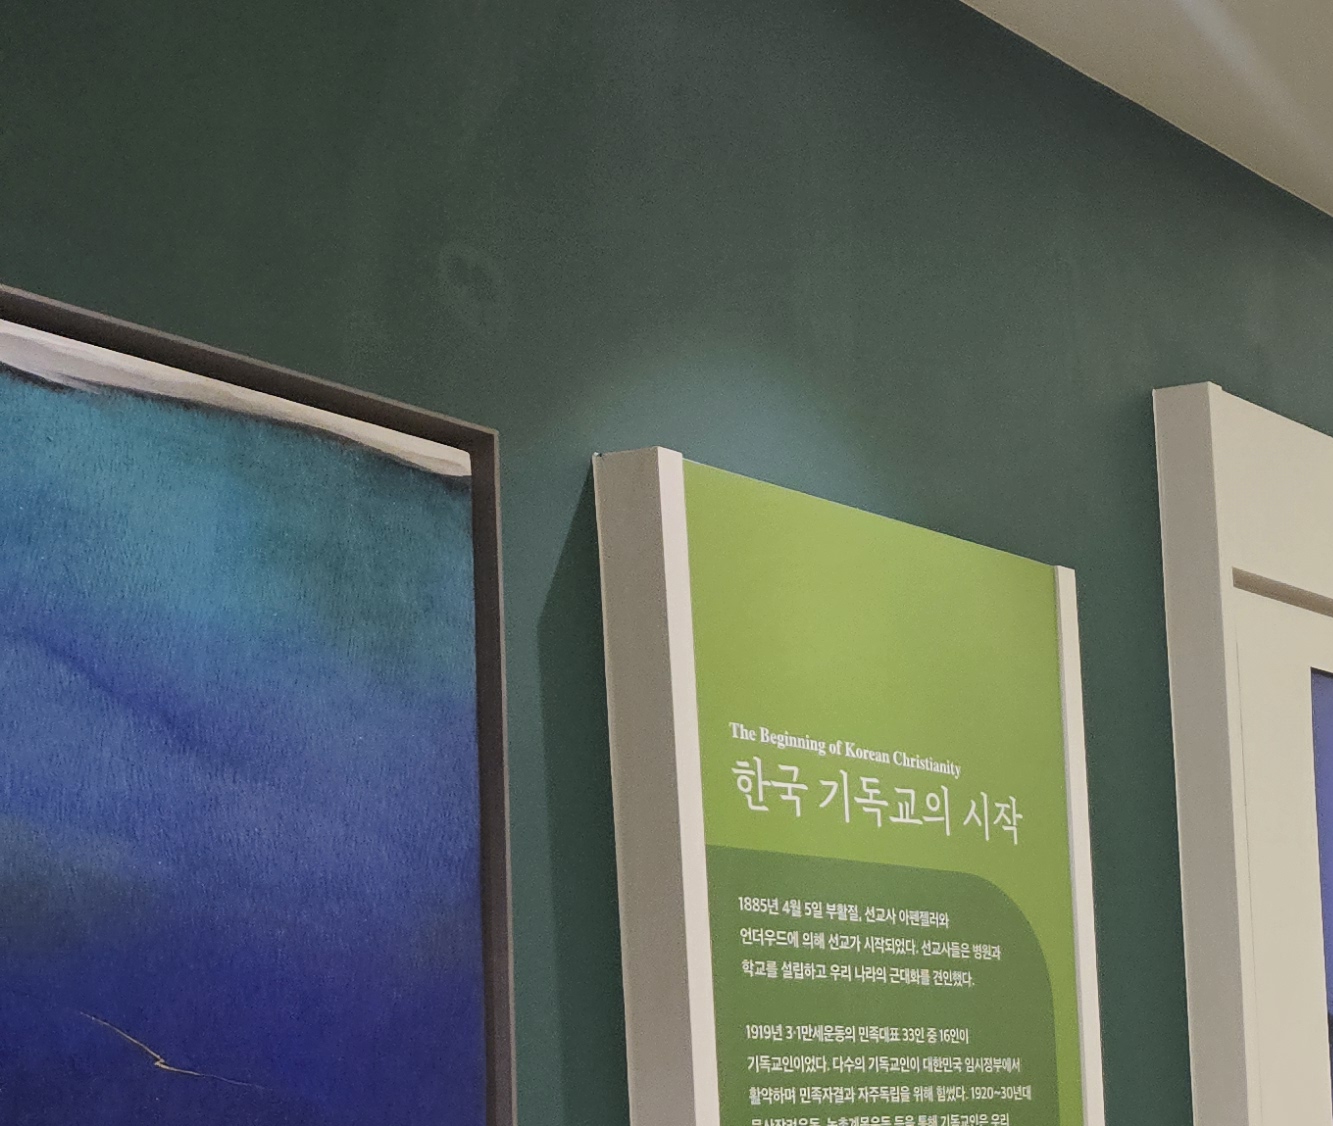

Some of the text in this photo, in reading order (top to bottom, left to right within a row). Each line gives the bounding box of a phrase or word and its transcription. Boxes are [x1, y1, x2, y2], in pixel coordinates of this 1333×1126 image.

[729, 722, 961, 779] The Beginning of Korean Christianity
[731, 756, 1023, 845] 한국 기독교의 시작
[738, 896, 950, 929] 1885년 4월 5일 부활절, 선교사 아펜젤러와
[740, 927, 1001, 960] 언더우드에 의해 선교가 시작되었다. 선교사들은 병원과
[741, 959, 975, 987] 학교를 설립하고 우리 나라의 근대화를 견인했다.
[745, 1024, 783, 1042] 1919년
[858, 1026, 901, 1043] 민족대표
[902, 1027, 925, 1044] 33인
[926, 1027, 938, 1044] 중
[939, 1028, 969, 1044] 16인이
[747, 1055, 1021, 1073] 기독교인이었다. 다수의 기독교인이 대한민국 임시정부에서
[749, 1086, 796, 1106] 활약하며
[799, 1086, 856, 1105] 민족자결과
[858, 1085, 911, 1104] 자주독립을
[913, 1085, 934, 1102] 위해
